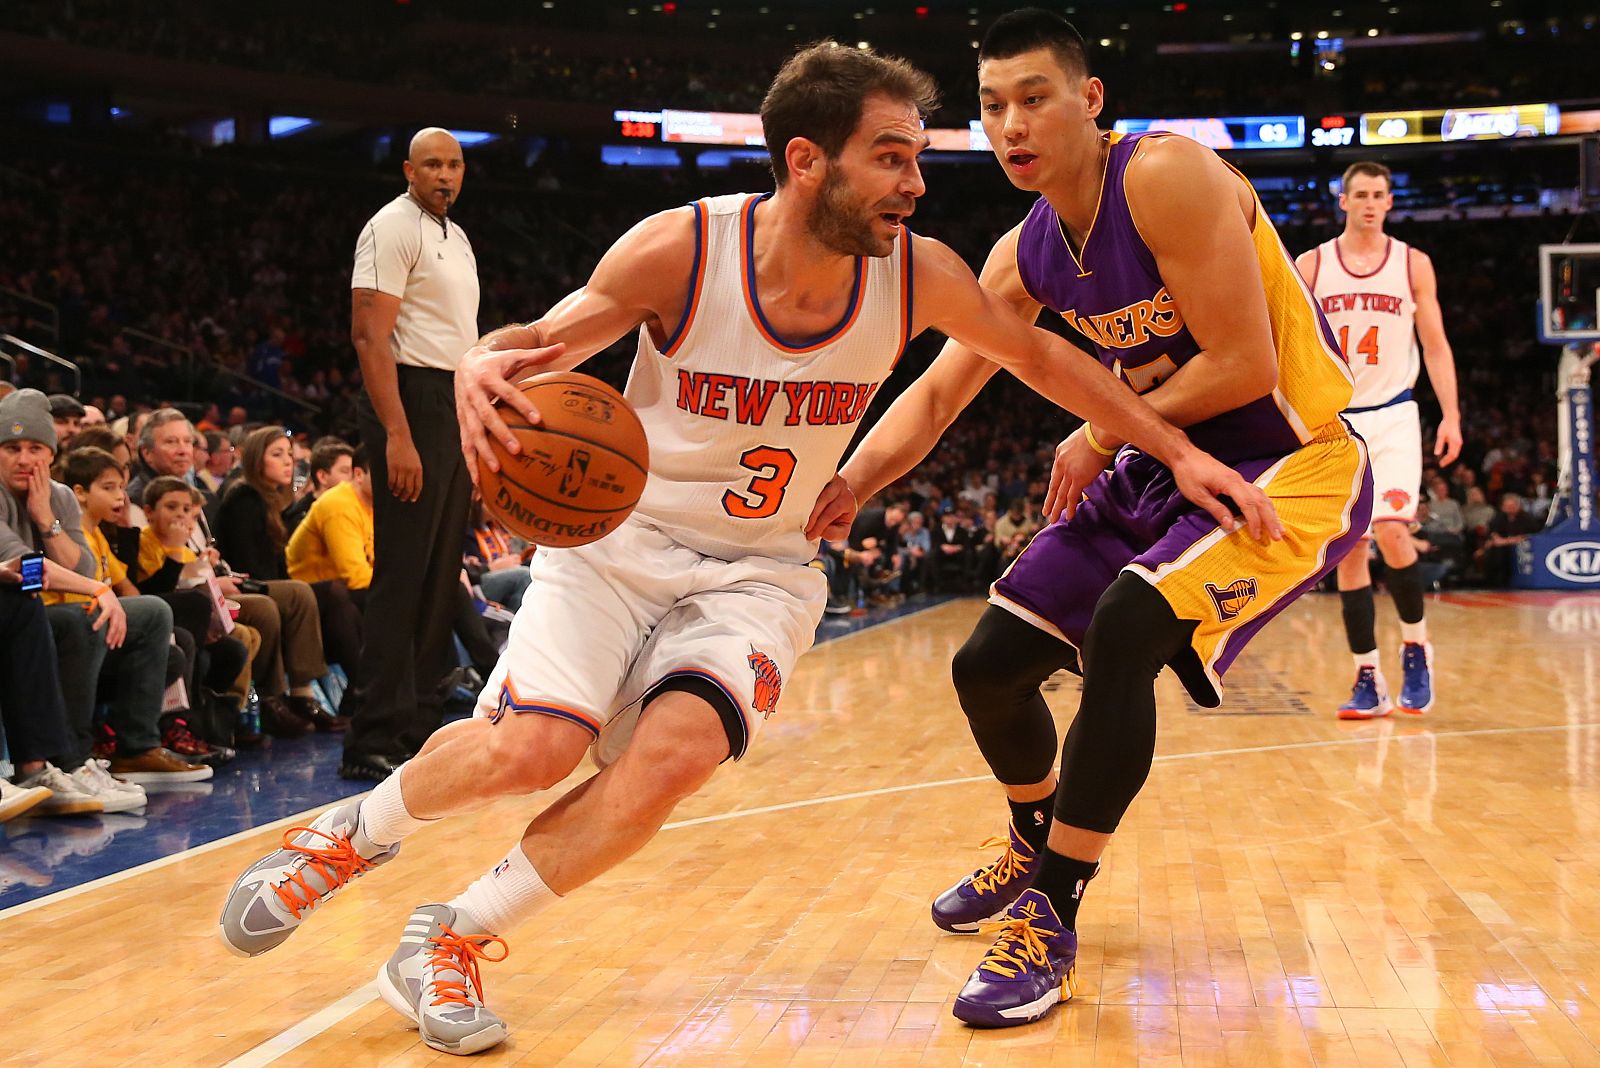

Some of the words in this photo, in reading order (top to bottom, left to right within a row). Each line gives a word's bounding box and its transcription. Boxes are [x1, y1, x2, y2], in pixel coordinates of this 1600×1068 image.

[1321, 293, 1357, 315] NEW
[1357, 292, 1402, 316] YORK
[1339, 325, 1379, 365] 14
[676, 368, 780, 427] NEW
[783, 381, 879, 426] YORK
[721, 444, 798, 519] 3
[496, 486, 613, 537] SPALDING
